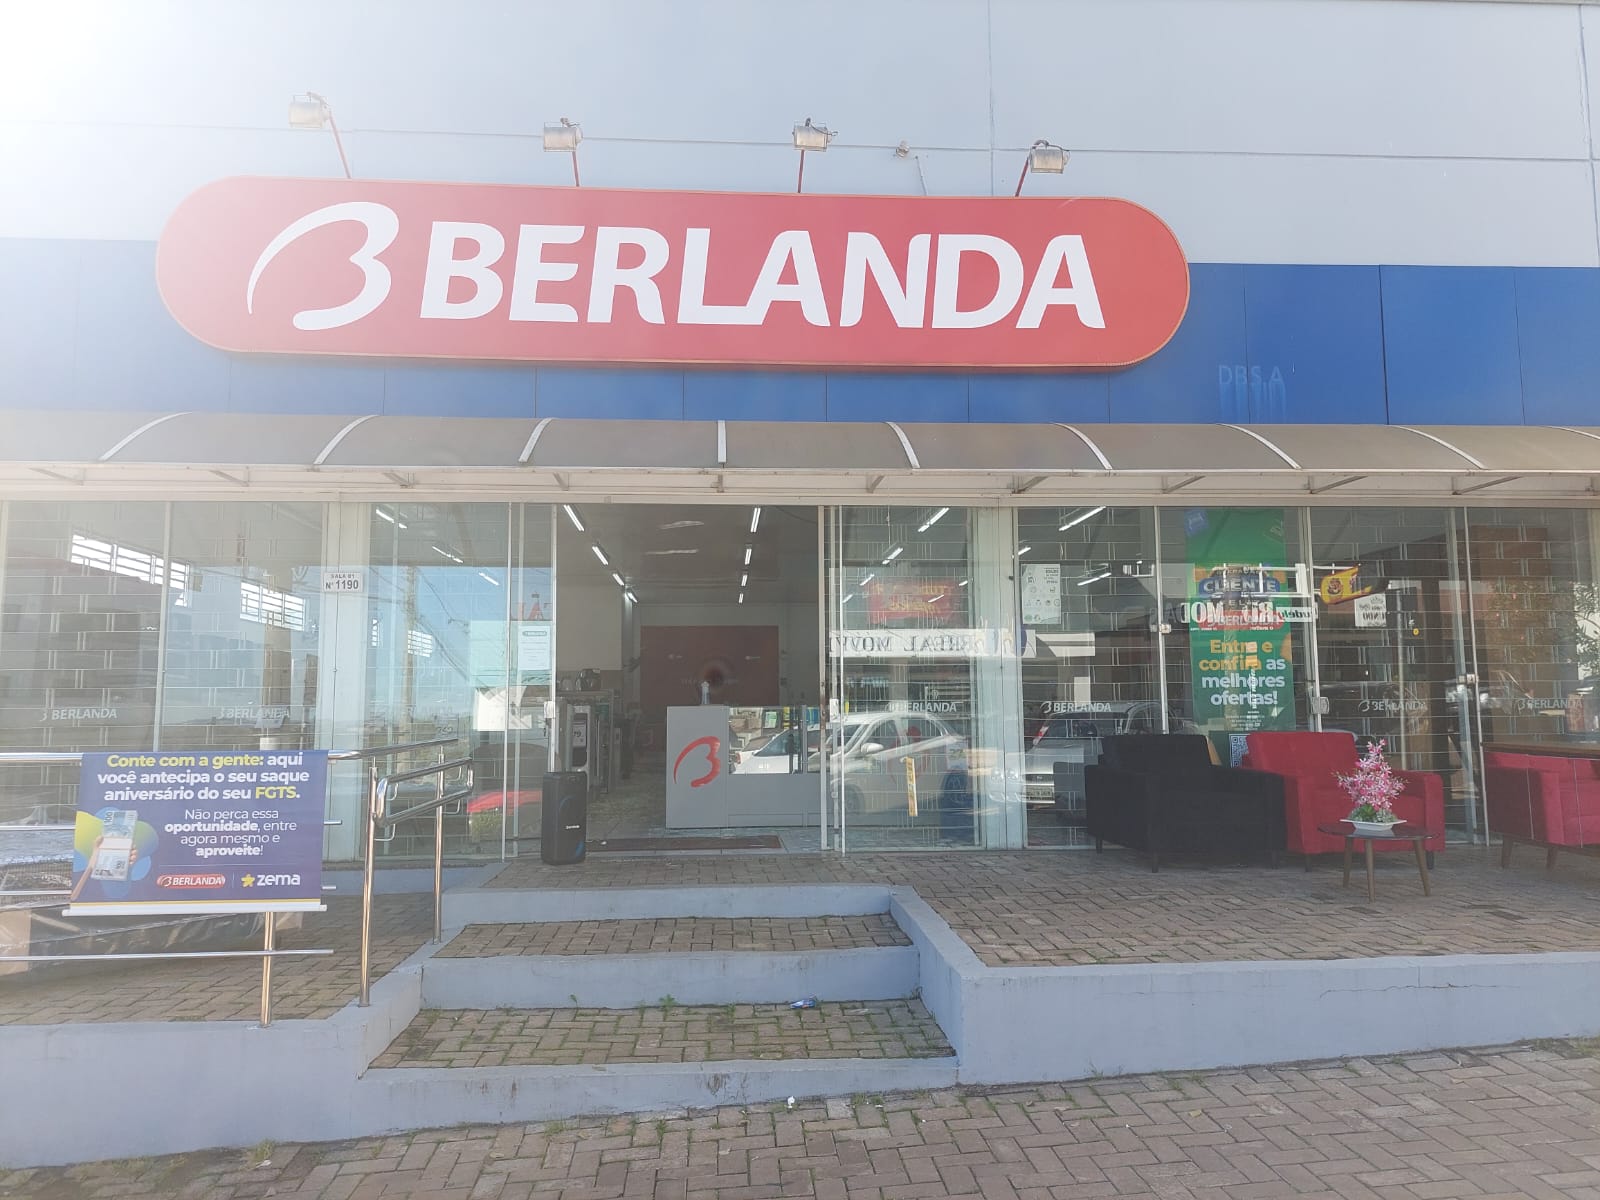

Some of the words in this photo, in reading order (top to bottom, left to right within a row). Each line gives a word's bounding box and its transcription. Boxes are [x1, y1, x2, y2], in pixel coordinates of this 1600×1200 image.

[420, 220, 1107, 330] BERLANDA
[335, 579, 359, 590] 1190
[1261, 641, 1273, 653] e
[1265, 658, 1287, 670] as
[1201, 672, 1286, 689] melhores
[1210, 690, 1278, 705] ofertas!
[1053, 701, 1112, 713] BERLANDA
[51, 708, 118, 721] BERLANDA
[107, 754, 156, 768] Conte
[159, 756, 195, 767] com
[199, 756, 209, 767] a
[212, 753, 264, 769] gente:
[267, 752, 303, 768] aqui
[97, 770, 137, 784] você
[140, 771, 210, 786] antecipa
[213, 772, 225, 783] o
[227, 772, 257, 783] seu
[260, 771, 310, 785] saque
[104, 786, 194, 801] aniversário
[197, 787, 219, 800] do
[222, 788, 251, 800] seu
[255, 786, 301, 799] FGTS.
[184, 809, 211, 820] Não
[213, 811, 249, 822] perca
[251, 809, 279, 819] essa
[164, 821, 261, 833] oportunidade,
[263, 821, 297, 831] entre
[180, 834, 217, 846] agora
[220, 834, 270, 844] mesmo
[272, 835, 280, 844] e
[195, 845, 264, 857] aproveite!
[172, 877, 223, 886] BERLANDA
[257, 874, 301, 886] zema
